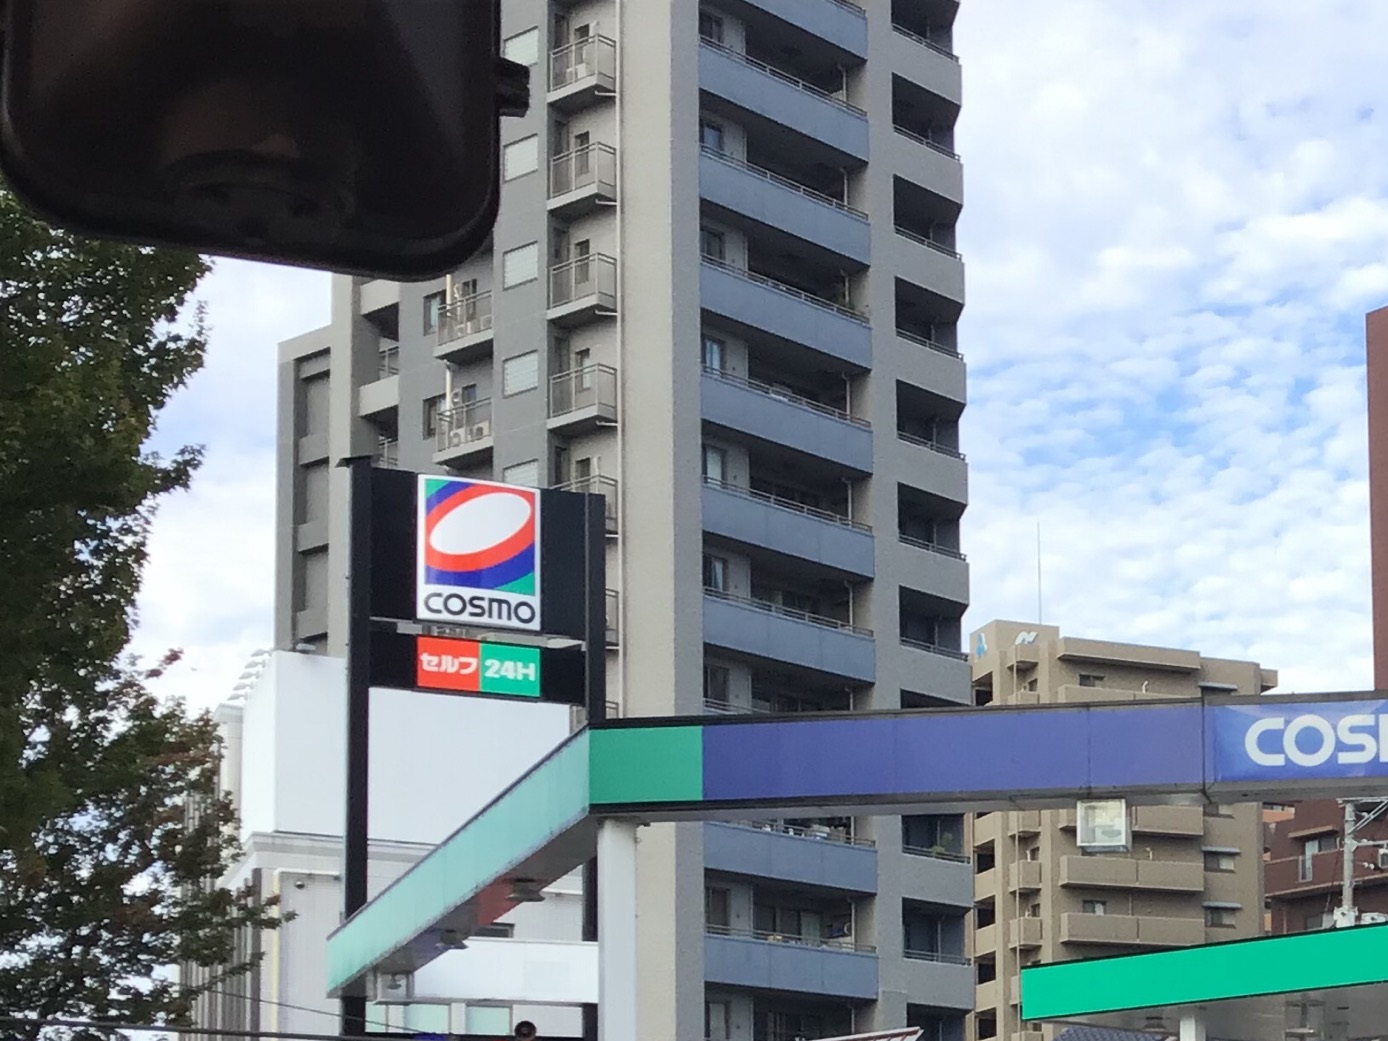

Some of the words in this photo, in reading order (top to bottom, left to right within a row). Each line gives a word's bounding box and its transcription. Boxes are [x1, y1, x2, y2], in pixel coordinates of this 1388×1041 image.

[424, 592, 536, 624] COSMO
[420, 652, 478, 674] セルフ
[484, 658, 536, 681] 24H
